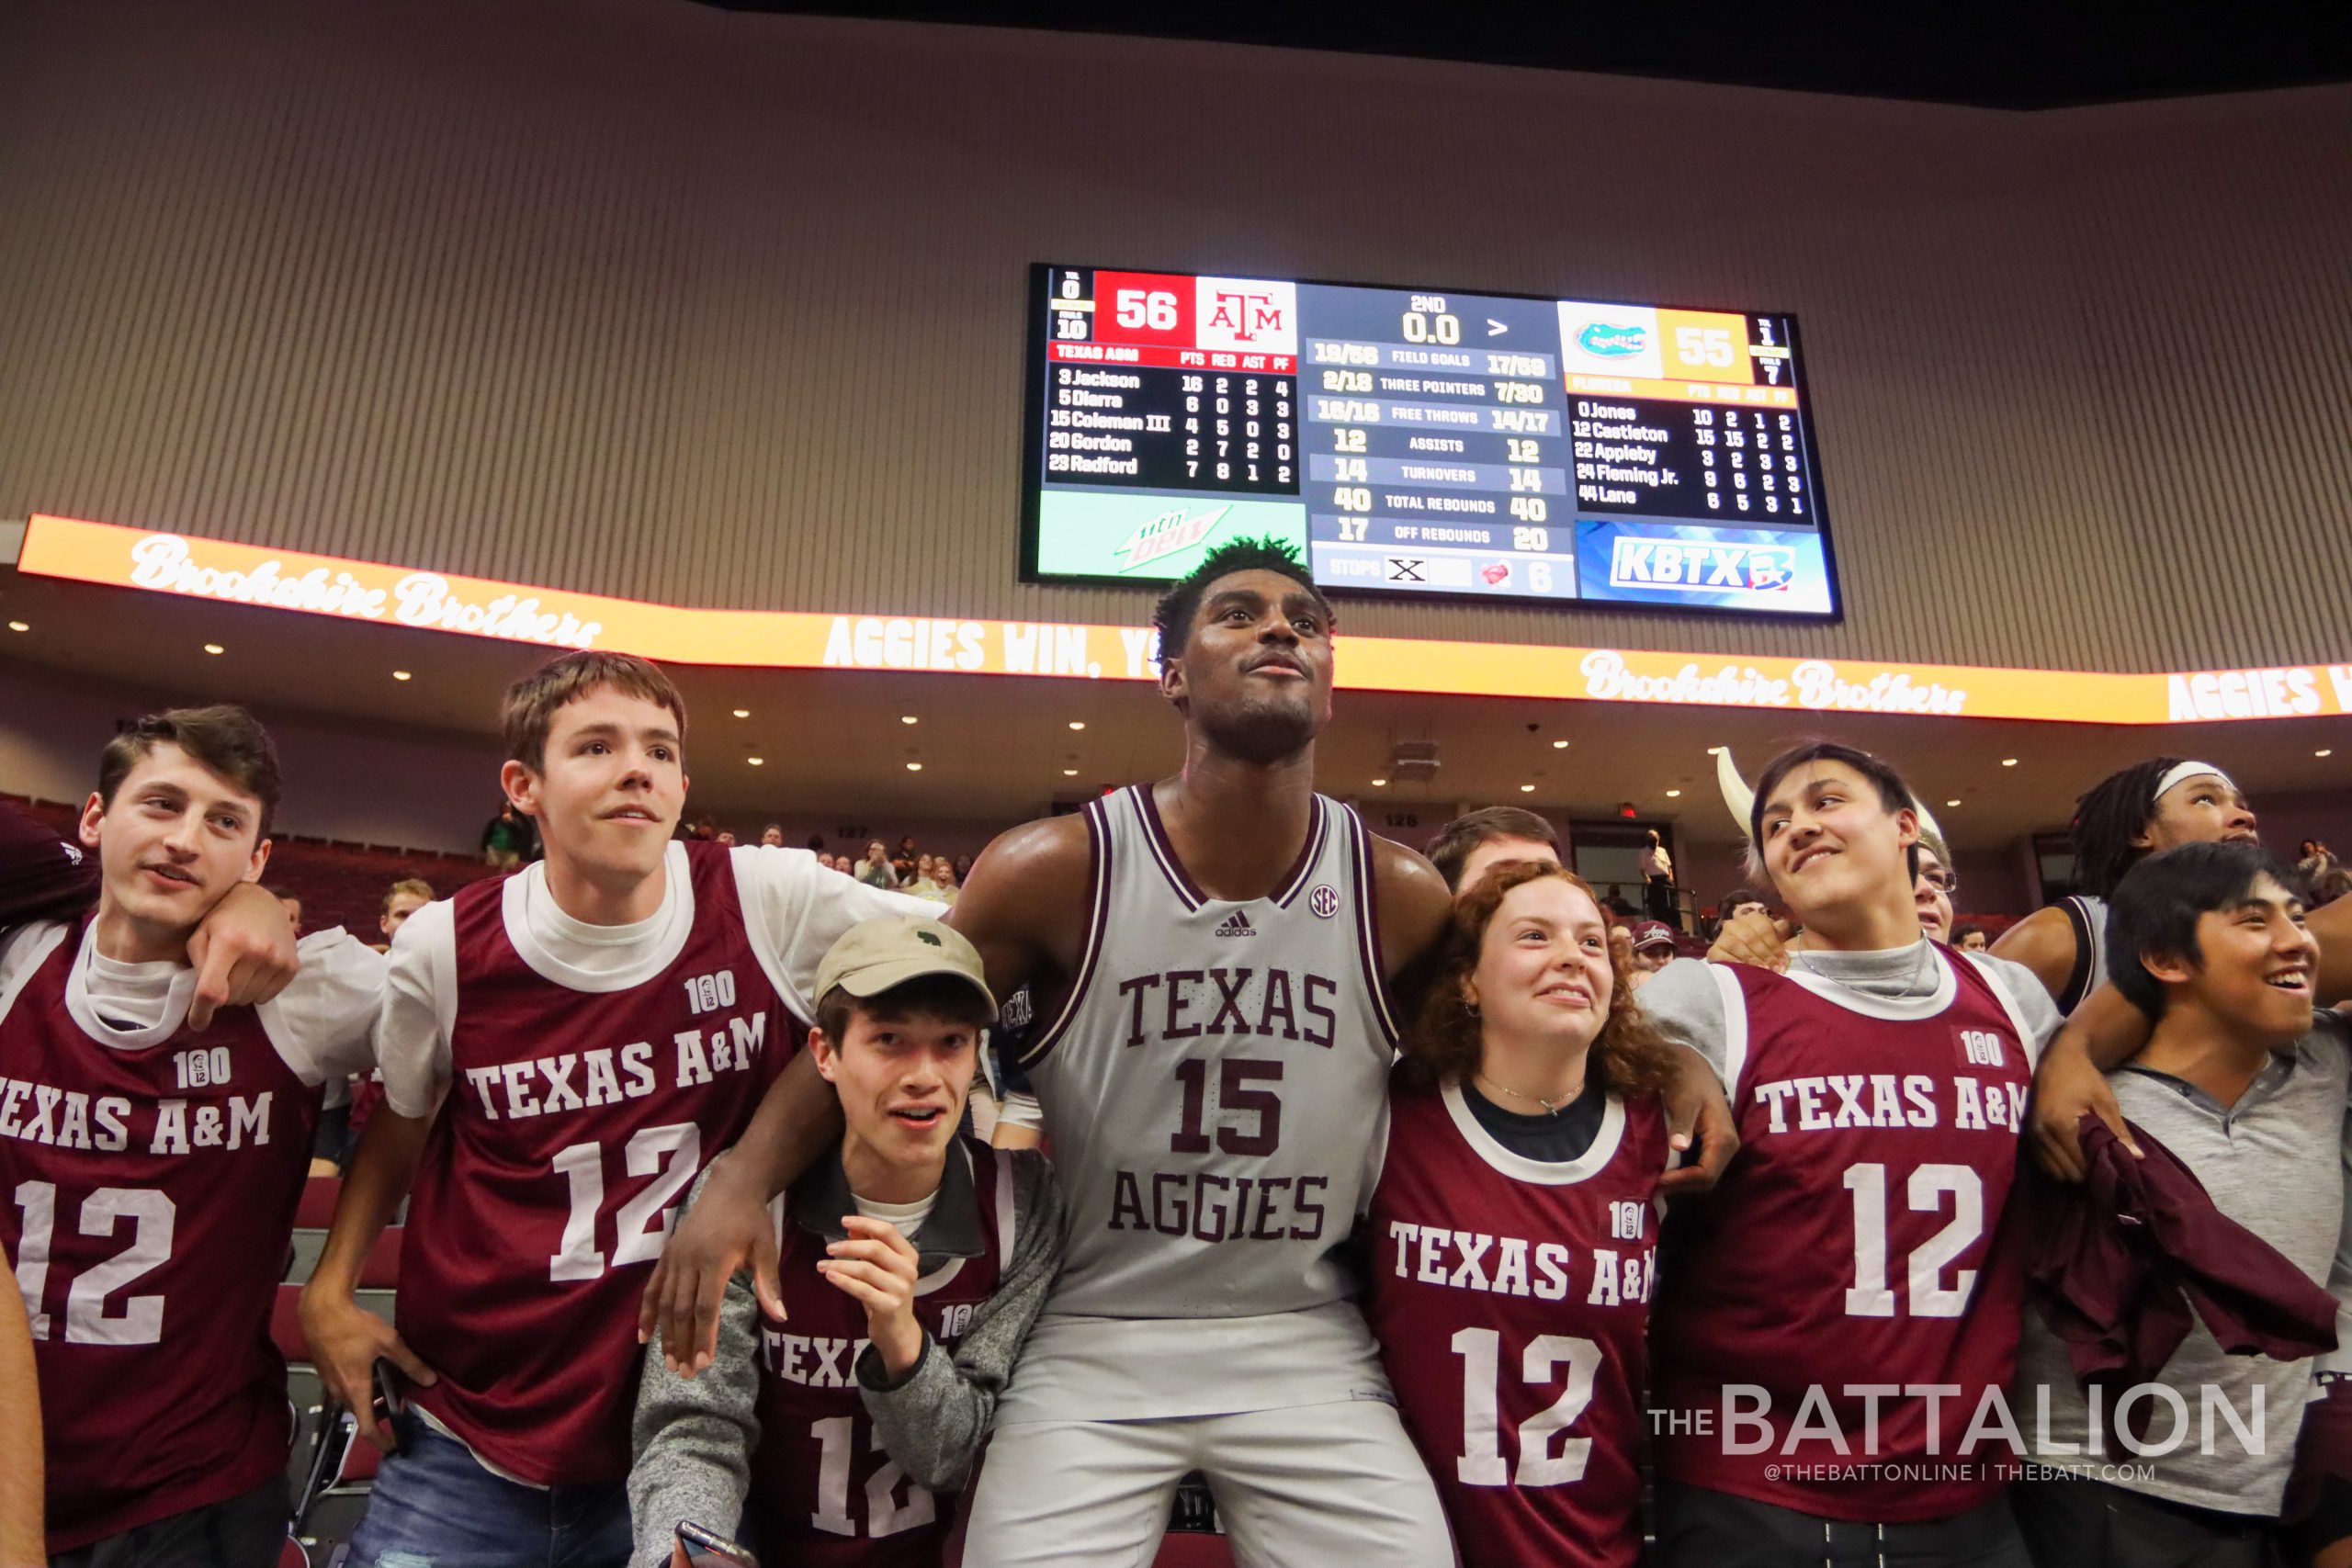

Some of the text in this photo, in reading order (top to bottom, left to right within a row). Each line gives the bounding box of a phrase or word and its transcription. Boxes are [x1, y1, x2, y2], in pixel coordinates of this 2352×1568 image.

[1062, 280, 1080, 299] 0
[1410, 295, 1446, 313] 2ND
[1116, 289, 1177, 330] 56
[1057, 319, 1087, 340] 10
[1402, 312, 1460, 344] 0.0
[1759, 327, 1774, 346] 1
[1057, 344, 1102, 360] TEXAS
[1181, 352, 1205, 366] PTS
[1212, 355, 1237, 367] REB
[1242, 355, 1266, 369] AST
[1273, 357, 1289, 370] PF
[1392, 350, 1429, 364] FIELD
[1430, 353, 1470, 367] GOALS
[1676, 327, 1735, 367] 55
[1058, 368, 1288, 397] 3 Jackson 16 2 2 4
[1323, 370, 1544, 403] 2/18 THREE POINTERS 7/30
[1764, 366, 1779, 385] 7
[1058, 389, 1289, 418] 5 Diarra 6 0 3 3
[1392, 407, 1422, 421] FREE
[1425, 409, 1478, 424] THROWS
[1492, 410, 1548, 432] 14/17
[1578, 401, 1791, 431] 0 Jones 10 2 1 2
[1051, 410, 1290, 439] 15 Coleman III 4 5 0 3
[1573, 421, 1793, 451] 12 Castleton 15 15 2 2
[1049, 432, 1290, 460] 20 Gordon 2 7 2 0
[1334, 428, 1539, 462] 12 ASSISTS 12
[1575, 441, 1593, 458] 22
[1595, 443, 1657, 466] Appleby
[1731, 452, 1743, 468] 2
[1759, 454, 1771, 470] 3
[1784, 455, 1796, 471] 3
[1049, 454, 1290, 482] 23 Radford 7 8 1 2
[1335, 458, 1543, 492] 14 TURNOVERS 14
[1577, 463, 1595, 479] 24
[1597, 464, 1659, 488] Fleming
[1661, 468, 1679, 485] Jr.
[1762, 474, 1774, 491] 2
[1788, 476, 1801, 492] 3
[1334, 487, 1546, 521] 40 TOTAL REBOUNDS 40
[1579, 484, 1802, 514] 44 Lane 6 5 3 1
[1339, 517, 1548, 551] 17 OFF REBOUNDS 20
[1330, 558, 1381, 577] STOPS
[1529, 561, 1553, 593] 6
[1619, 543, 1747, 586] KBTX
[130, 533, 602, 649] Brookshire Brothers
[823, 616, 1102, 679] AGGIES WIN,
[1580, 649, 1967, 715] Brookshire Brothers
[2167, 668, 2321, 721] AGGIES
[1311, 888, 1338, 916] SEC
[1215, 927, 1257, 937] adidas
[684, 970, 735, 1014] 100
[1119, 967, 1337, 1049] TEXAS
[173, 1046, 232, 1089] 100
[194, 1071, 206, 1083] 12
[465, 1011, 766, 1121] TEXAS A&M
[0, 1076, 273, 1155] EXAS A&M
[1170, 1058, 1283, 1157] 15
[1754, 1075, 1938, 1134] TEXAS
[550, 1121, 700, 1282] 12
[1108, 1170, 1329, 1243] AGGIES
[1843, 1162, 1983, 1317] 12
[15, 1179, 176, 1345] 12
[1389, 1220, 1568, 1301] TEXAS
[941, 1303, 979, 1338] 10
[1452, 1326, 1603, 1487] 12
